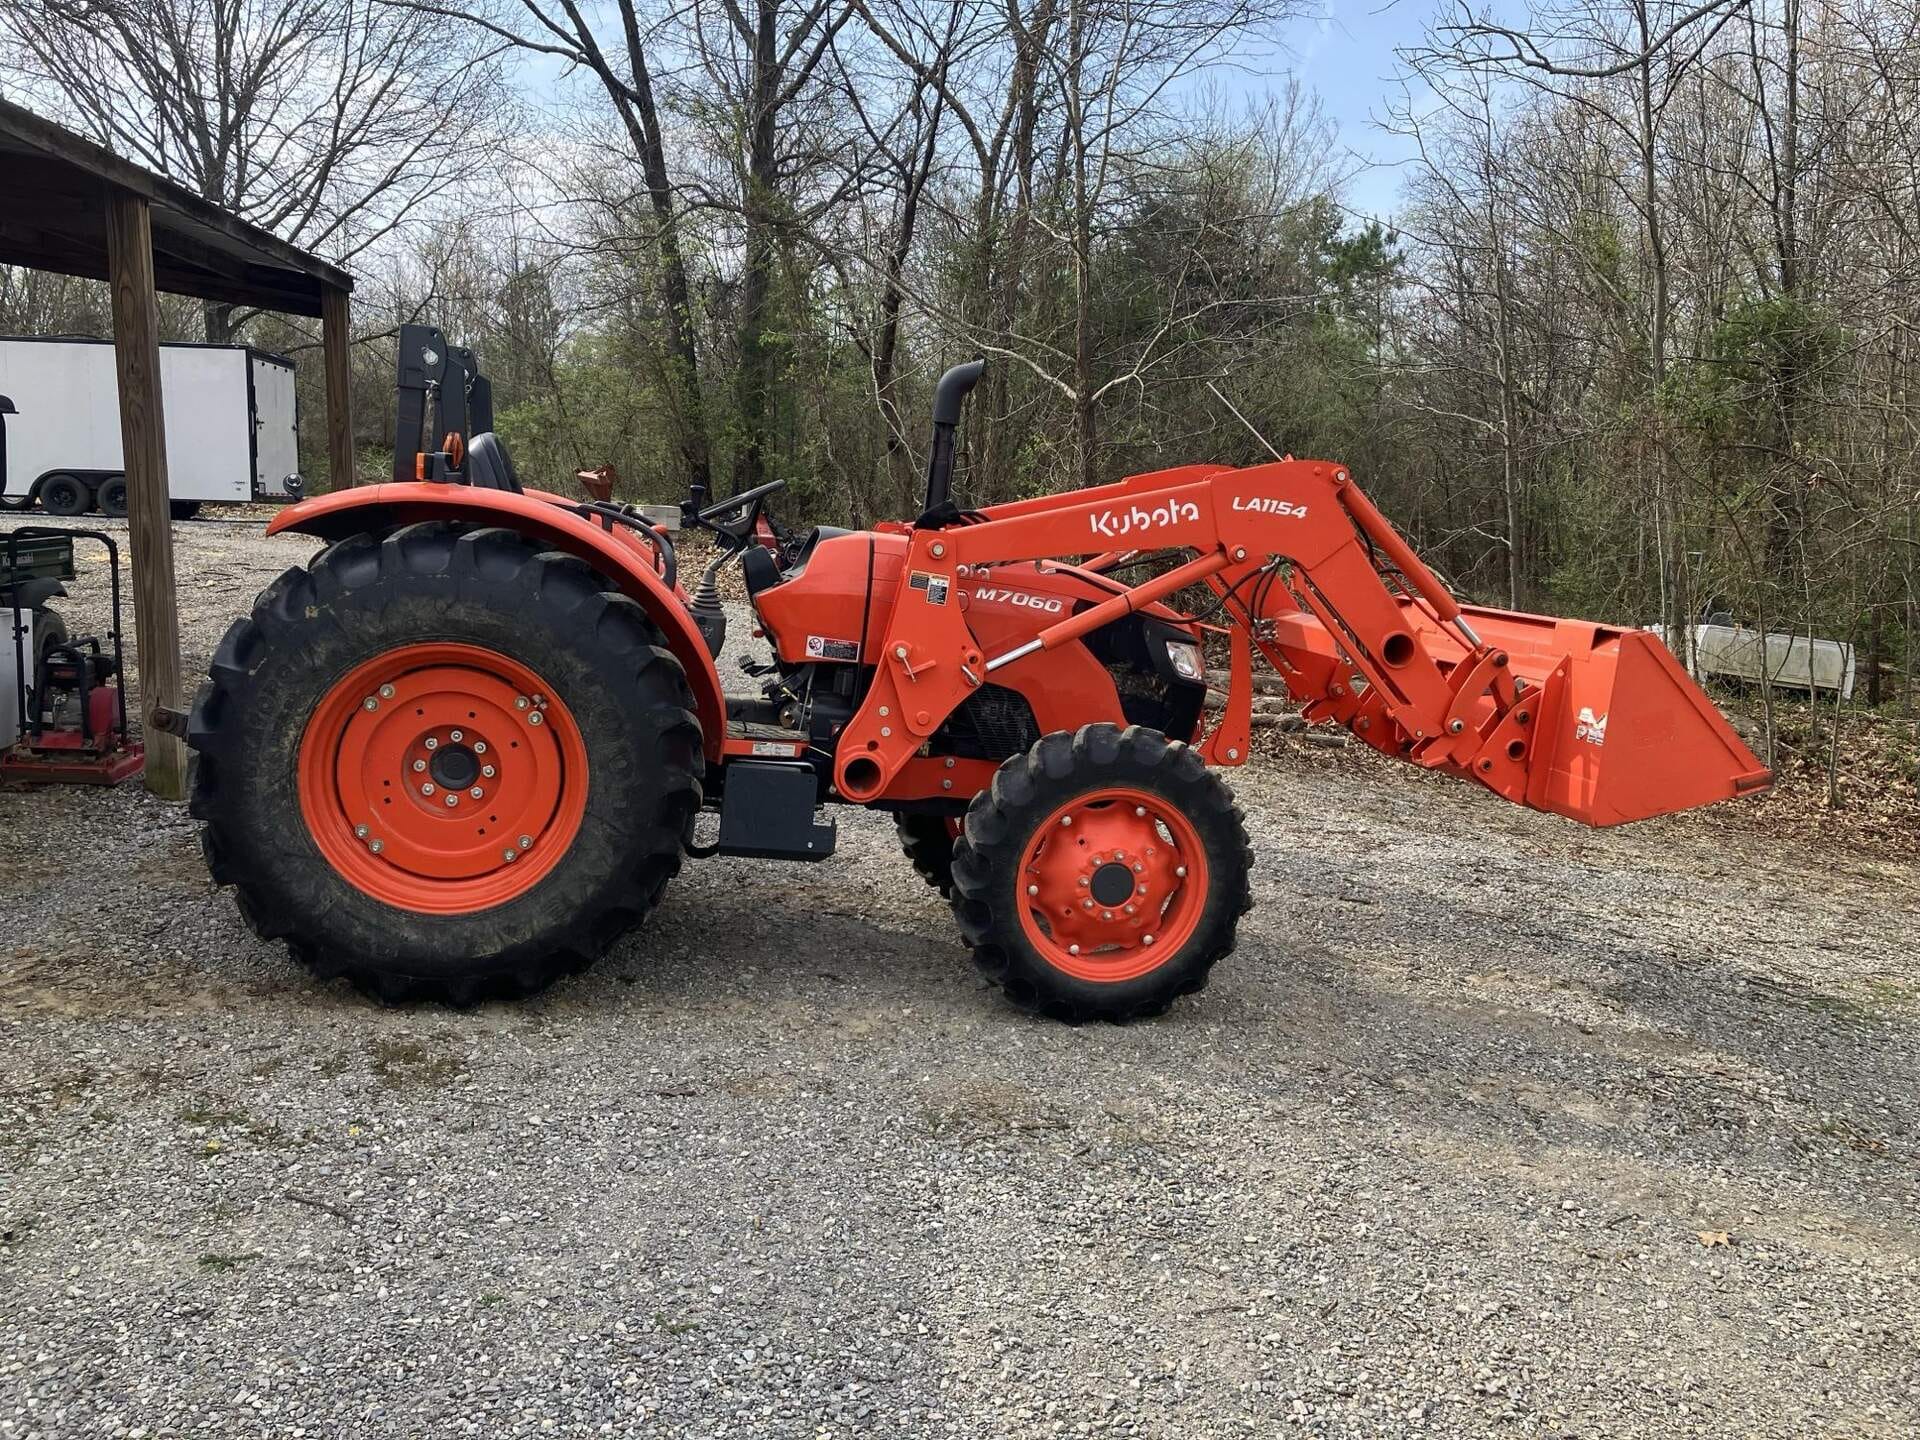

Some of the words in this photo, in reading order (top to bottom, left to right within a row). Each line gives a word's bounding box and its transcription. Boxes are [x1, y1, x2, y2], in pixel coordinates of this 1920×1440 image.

[1090, 498, 1200, 537] Kubota
[1232, 496, 1308, 519] LA1154
[976, 586, 1064, 614] M7060
